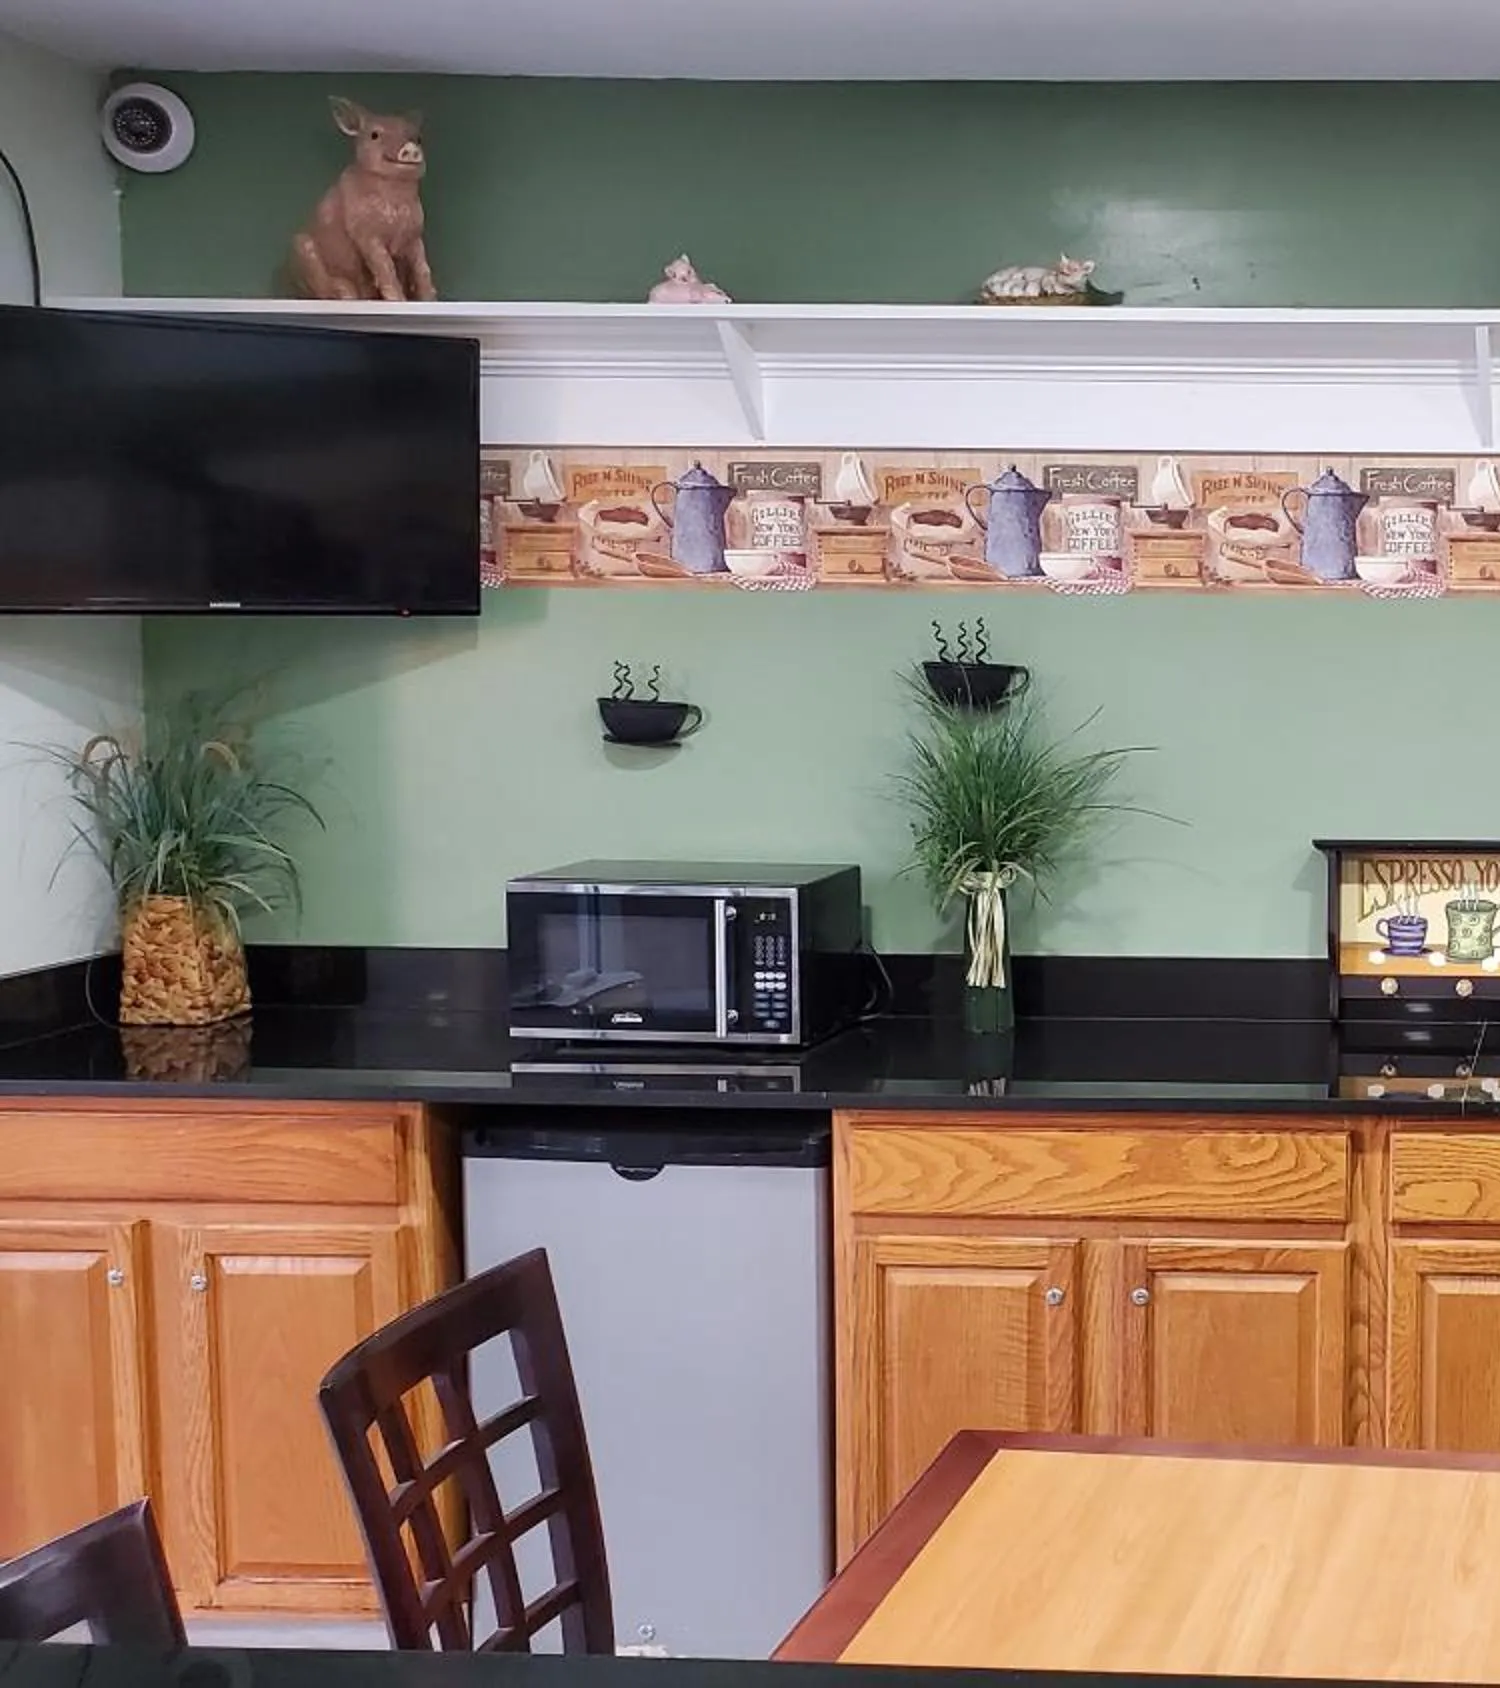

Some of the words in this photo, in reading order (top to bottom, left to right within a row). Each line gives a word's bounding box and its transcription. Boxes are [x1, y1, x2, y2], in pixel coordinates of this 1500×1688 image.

[771, 467, 819, 487] Coffee
[1087, 471, 1137, 490] Coffee
[1404, 473, 1453, 494] Coffee
[1358, 858, 1463, 923] ESPRESSO
